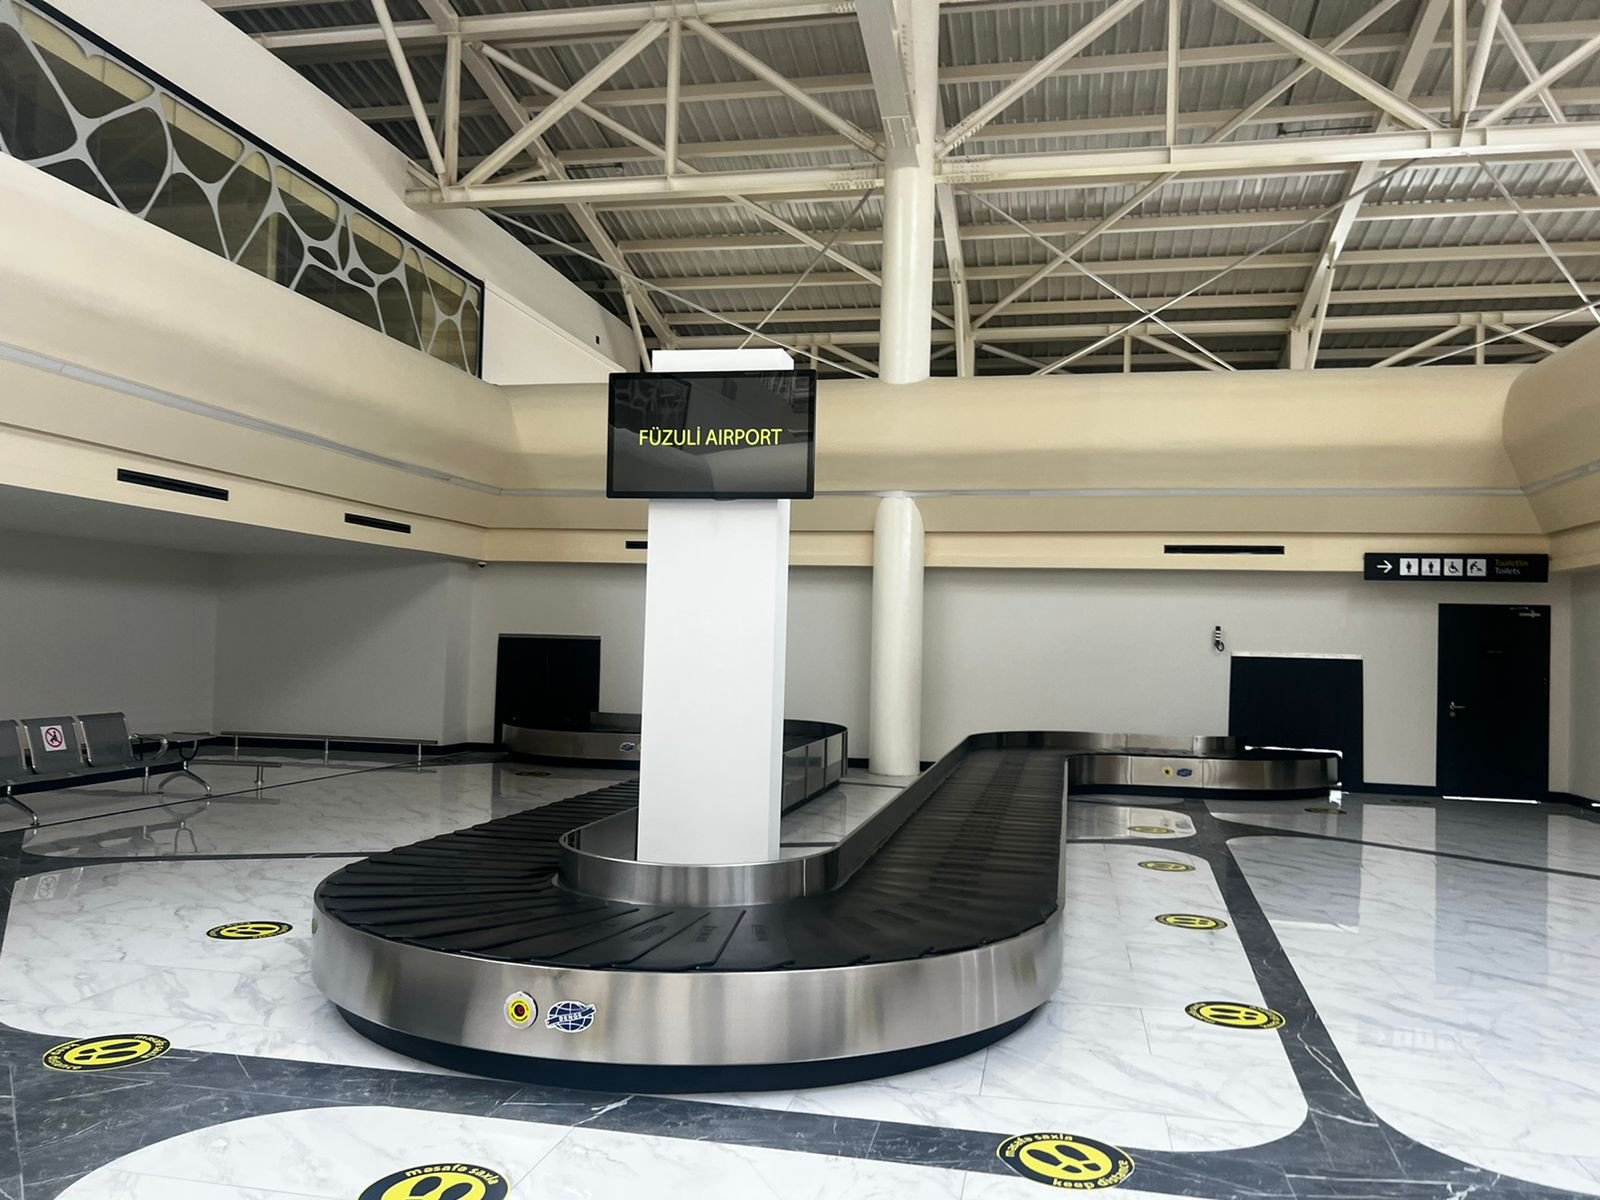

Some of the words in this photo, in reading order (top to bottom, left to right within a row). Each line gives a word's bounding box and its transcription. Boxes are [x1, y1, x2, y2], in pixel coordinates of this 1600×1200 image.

[639, 426, 701, 446] FÜZULİ
[705, 428, 783, 446] AIRPORT
[1495, 567, 1521, 575] Toilets
[468, 1167, 499, 1185] saxla
[1052, 1178, 1094, 1190] keep
